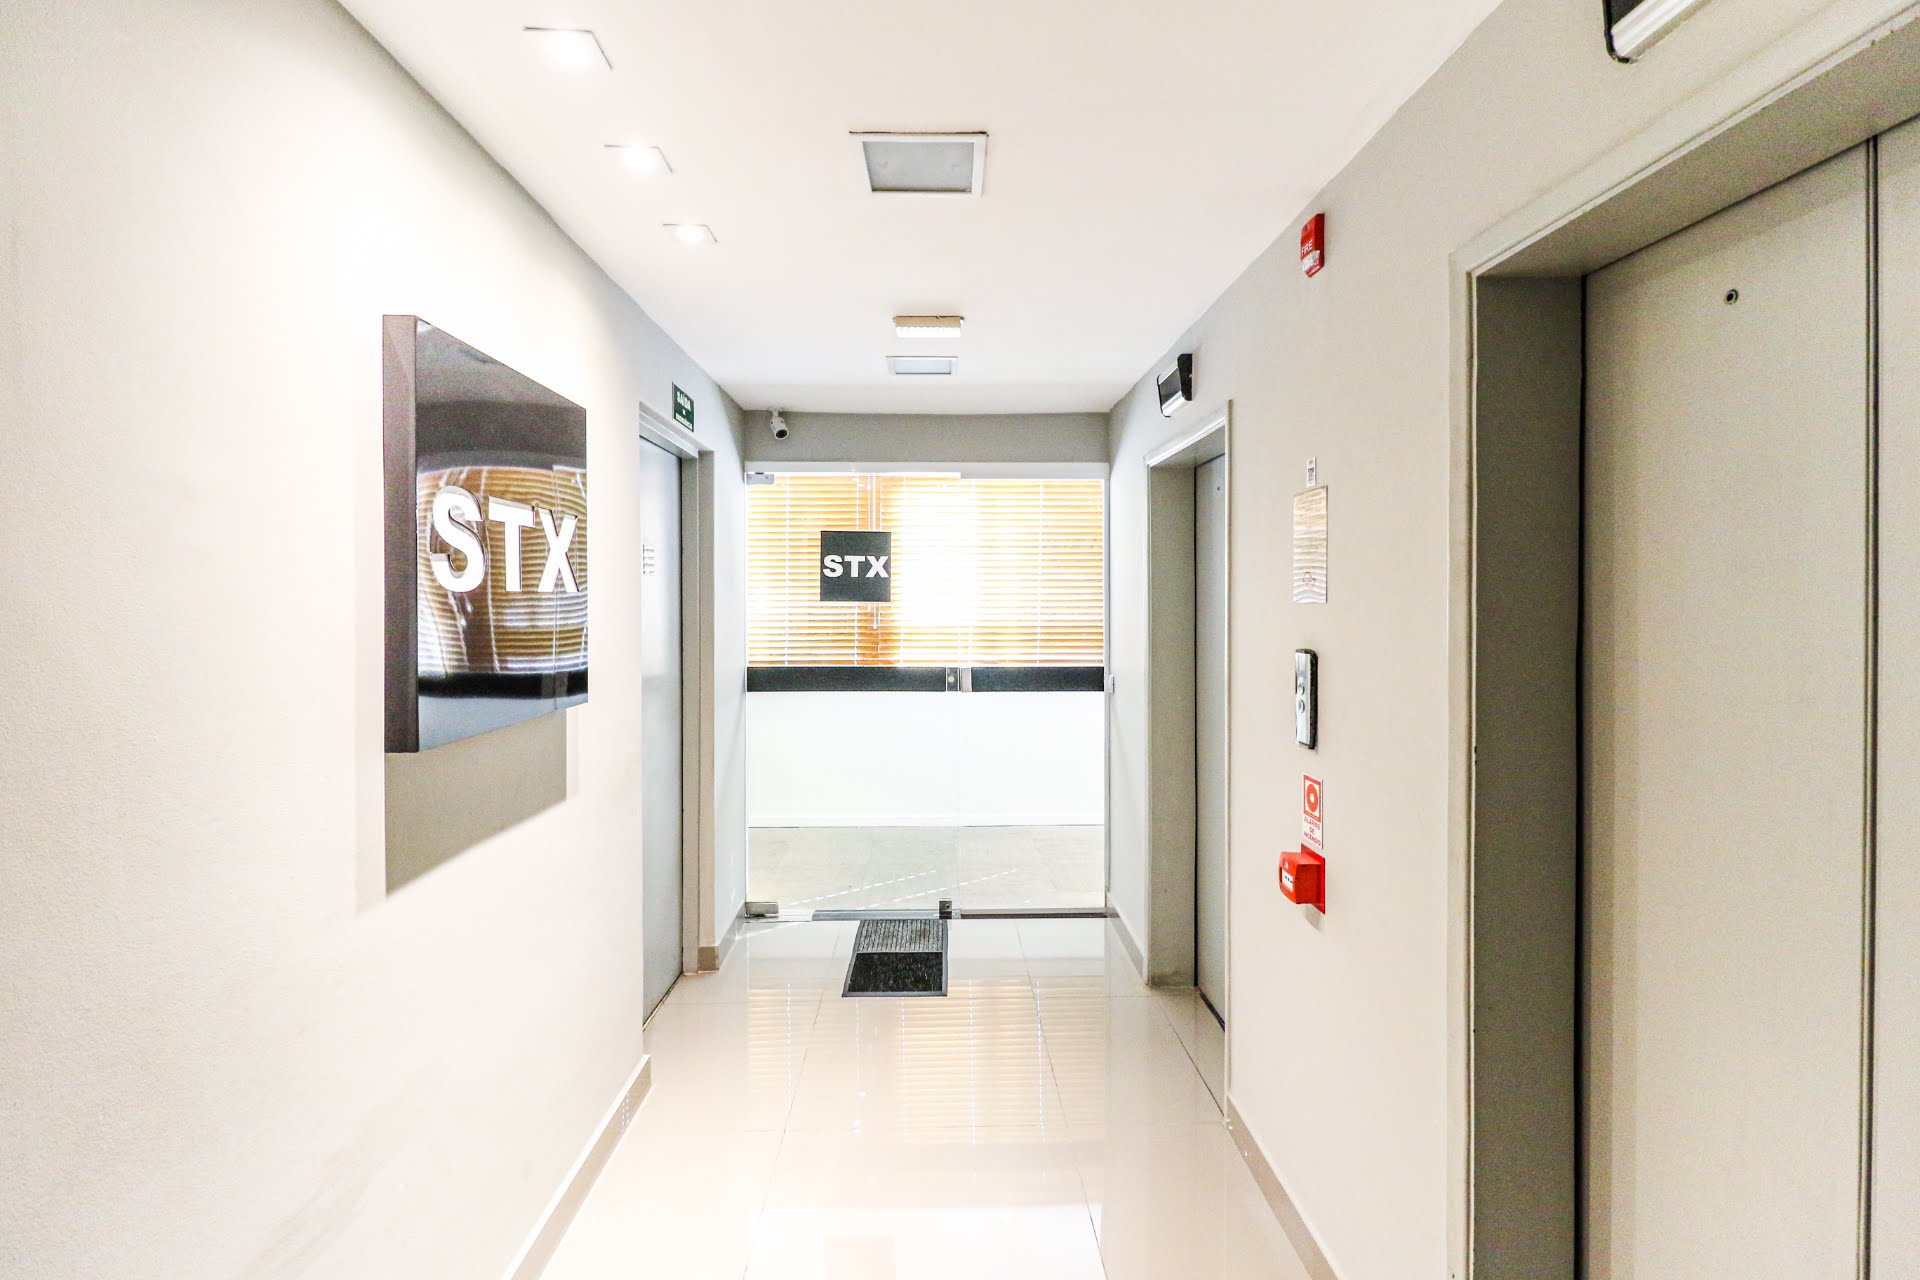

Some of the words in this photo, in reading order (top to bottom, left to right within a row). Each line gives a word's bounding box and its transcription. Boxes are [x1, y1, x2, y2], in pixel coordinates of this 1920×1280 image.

[1302, 239, 1313, 255] FIRE
[429, 486, 580, 594] STX
[823, 554, 889, 578] STX
[1304, 815, 1320, 831] ALARME
